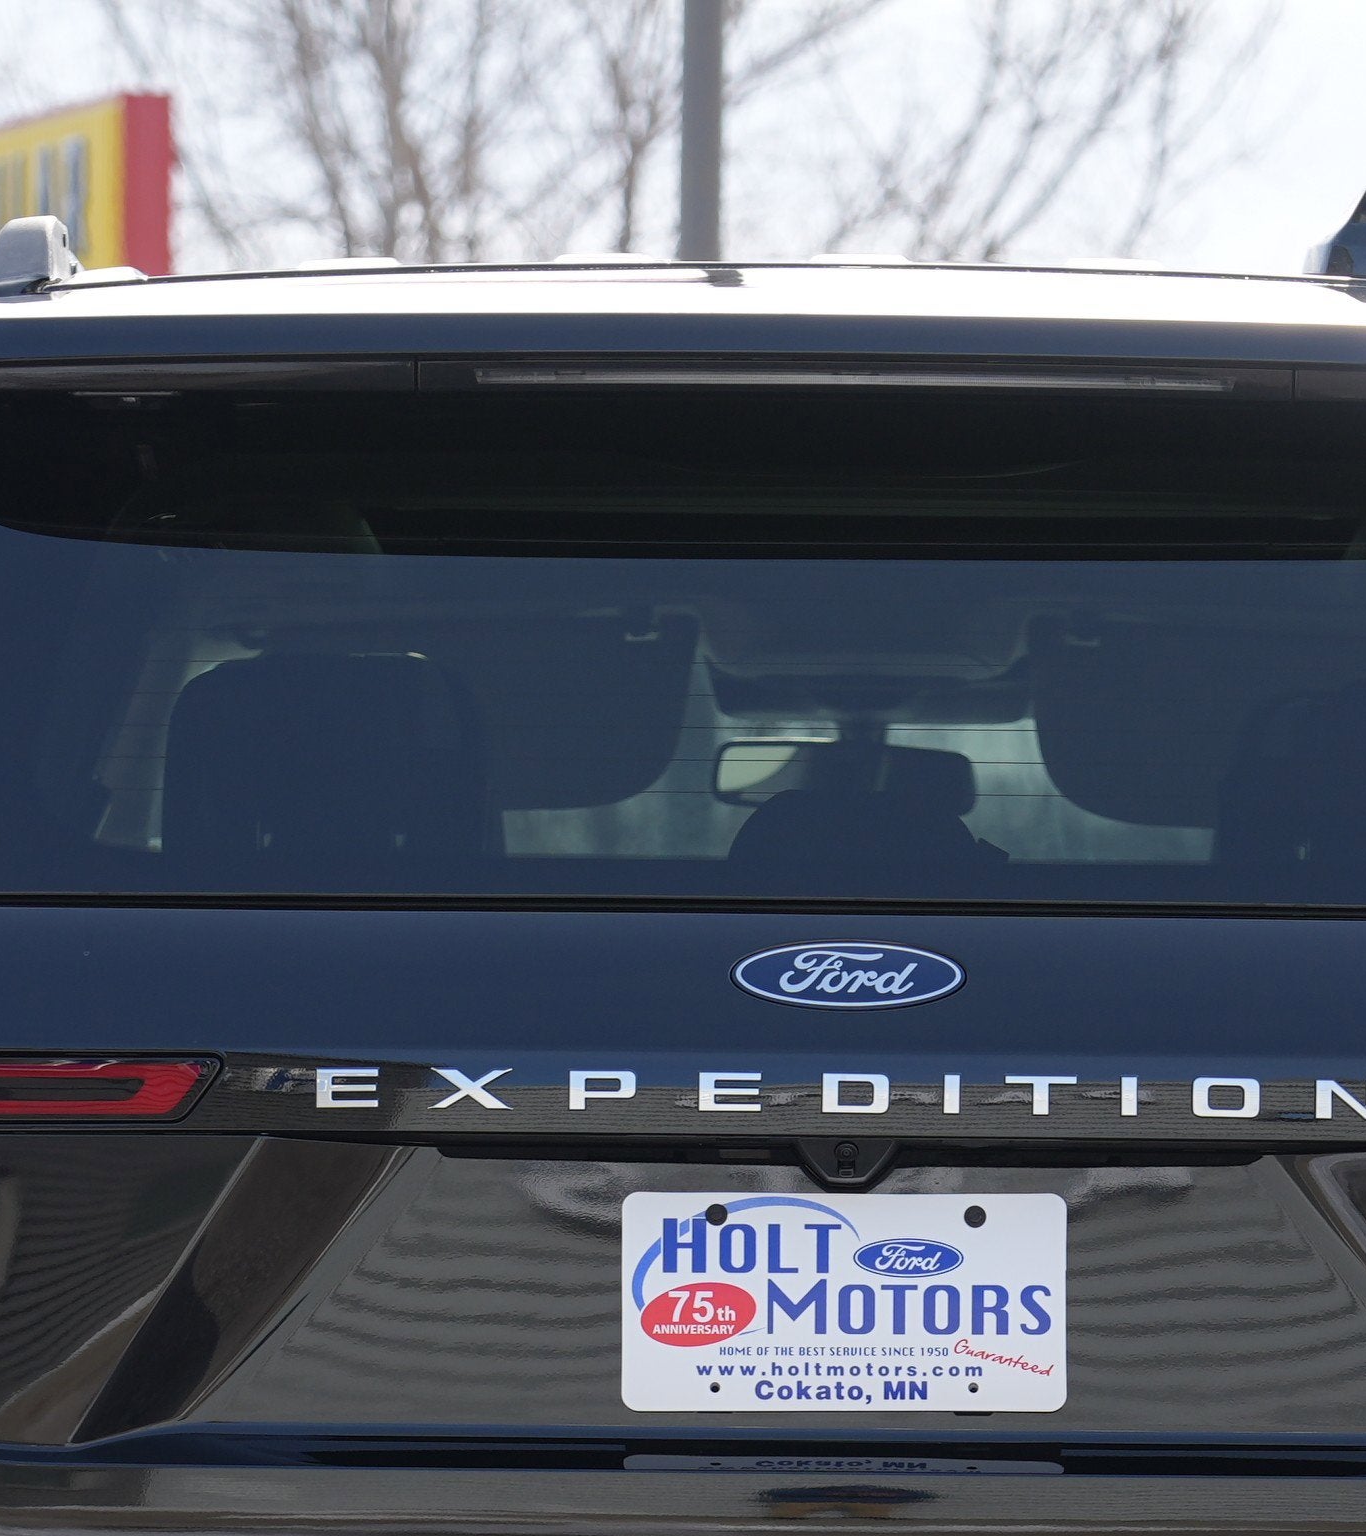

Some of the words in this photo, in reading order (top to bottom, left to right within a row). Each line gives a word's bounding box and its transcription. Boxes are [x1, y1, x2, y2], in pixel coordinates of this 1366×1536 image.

[779, 948, 917, 997] Ford
[662, 1218, 841, 1273] HOLT
[875, 1244, 942, 1272] Ford
[668, 1290, 736, 1322] 75th
[767, 1278, 1051, 1335] MOTORS
[652, 1324, 735, 1335] ANNIVERSARY
[719, 1347, 752, 1356] HOME
[756, 1347, 769, 1356] OF
[773, 1347, 795, 1356] THE
[799, 1347, 825, 1356] BEST
[829, 1347, 877, 1356] SERVICE
[881, 1347, 915, 1356] SINCE
[920, 1347, 950, 1356] 1950
[953, 1338, 1053, 1377] Guaranteed
[696, 1361, 984, 1377] www.holtmotors.com
[754, 1380, 873, 1404] Cokato,
[883, 1381, 929, 1400] MN
